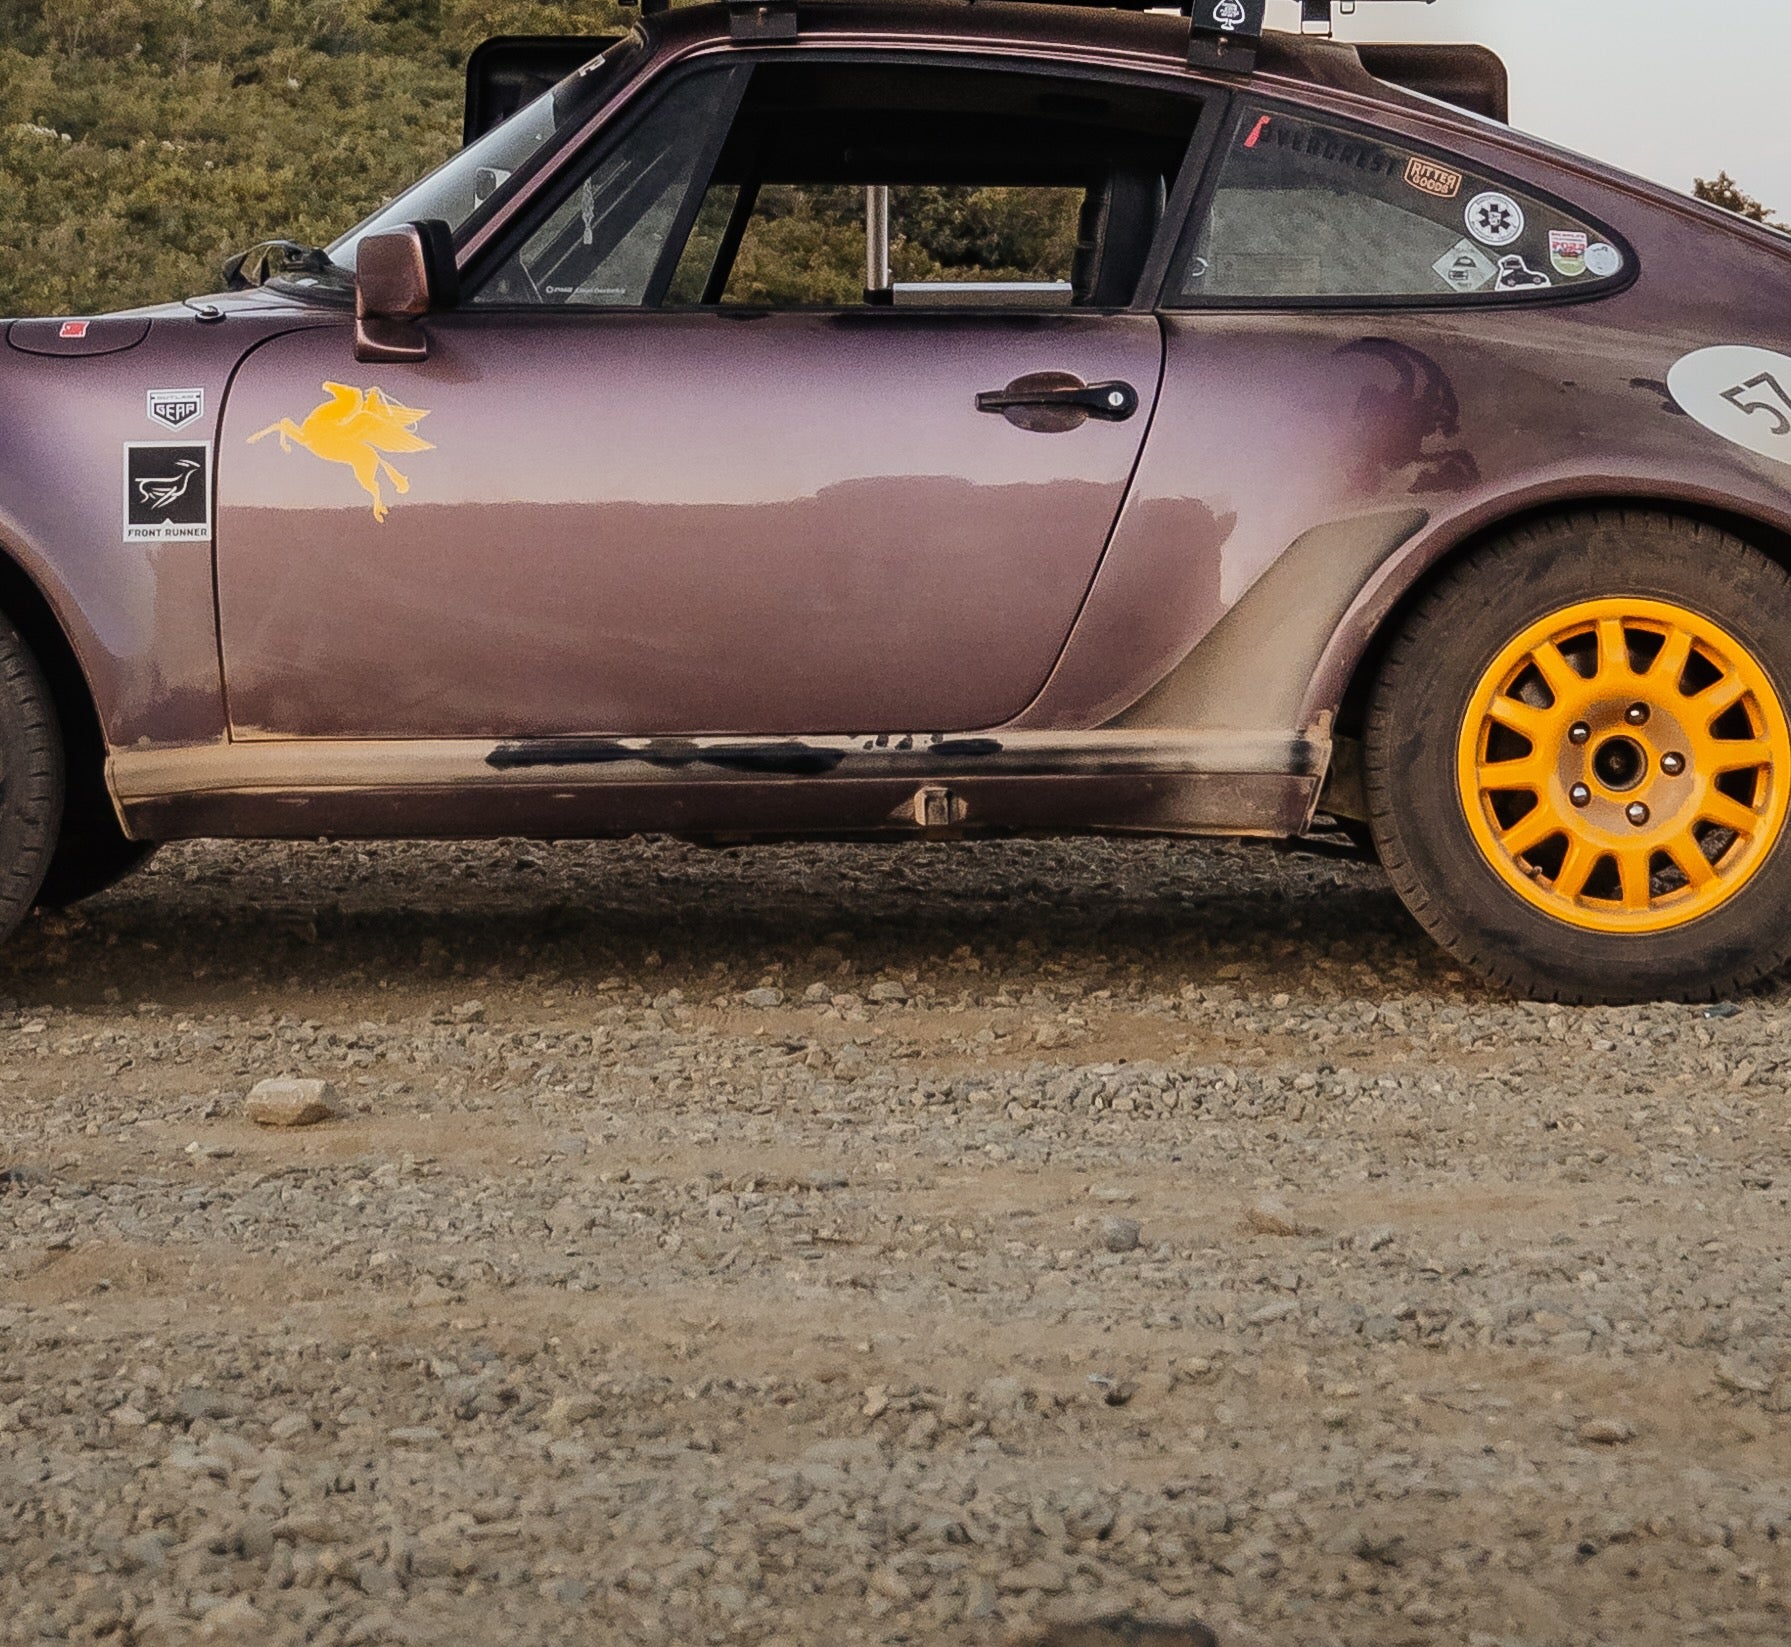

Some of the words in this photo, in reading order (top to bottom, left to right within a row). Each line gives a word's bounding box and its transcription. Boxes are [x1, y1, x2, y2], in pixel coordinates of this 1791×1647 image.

[155, 402, 196, 421] GEAR
[127, 528, 162, 537] FRONT
[164, 527, 207, 537] RUNNER
